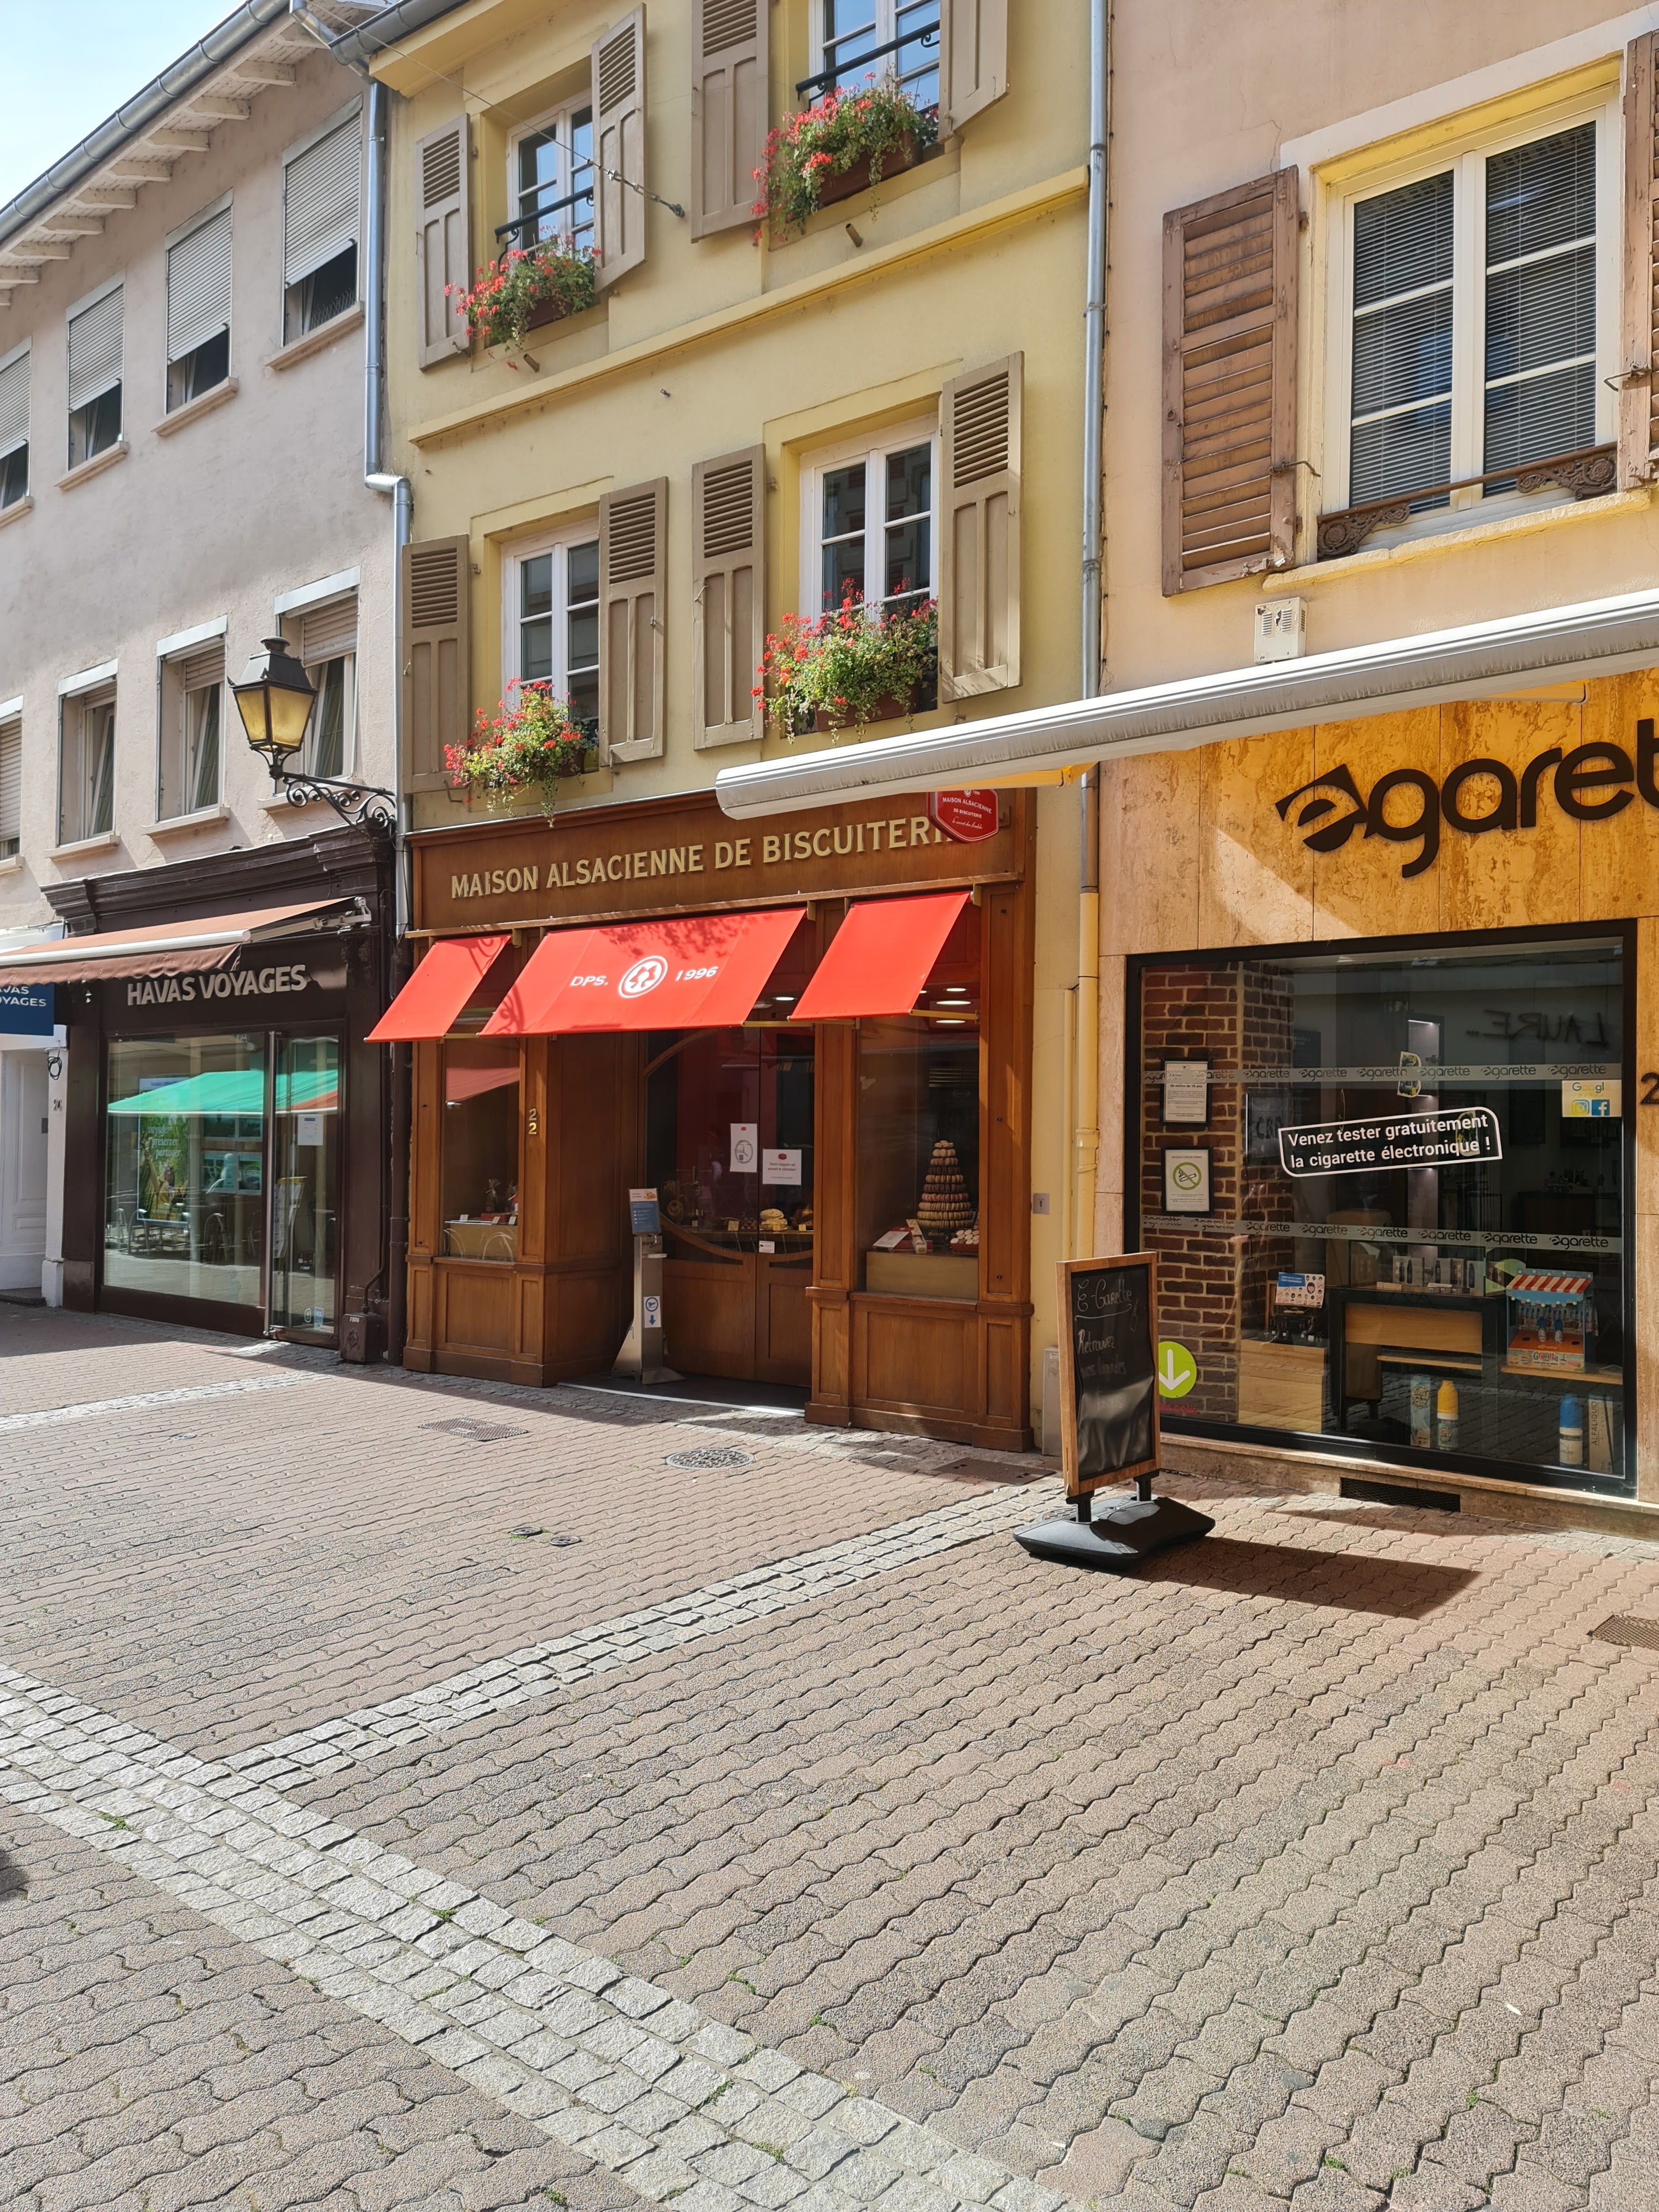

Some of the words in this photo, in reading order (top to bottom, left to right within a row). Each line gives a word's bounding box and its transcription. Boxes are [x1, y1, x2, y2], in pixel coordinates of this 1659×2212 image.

[959, 810, 982, 818] BISCUITERIE
[962, 799, 992, 814] ALSACIENNE
[451, 865, 539, 899] MAISON
[546, 845, 703, 888] ALSACIENNE
[715, 838, 751, 869] DE
[128, 977, 196, 1005] HAVAS
[199, 964, 307, 999] VOYAGES
[570, 975, 608, 987] DPS.
[675, 966, 718, 982] 1996
[0, 985, 29, 994] VAS
[0, 996, 46, 1006] YAGES
[1288, 1132, 1333, 1147] Venez
[1337, 1126, 1381, 1142] tester
[1385, 1114, 1489, 1140] gratuitement
[1291, 1154, 1304, 1168] la
[1309, 1148, 1375, 1168] cigarette
[1381, 1139, 1479, 1160] électronique
[1485, 1136, 1490, 1150] !
